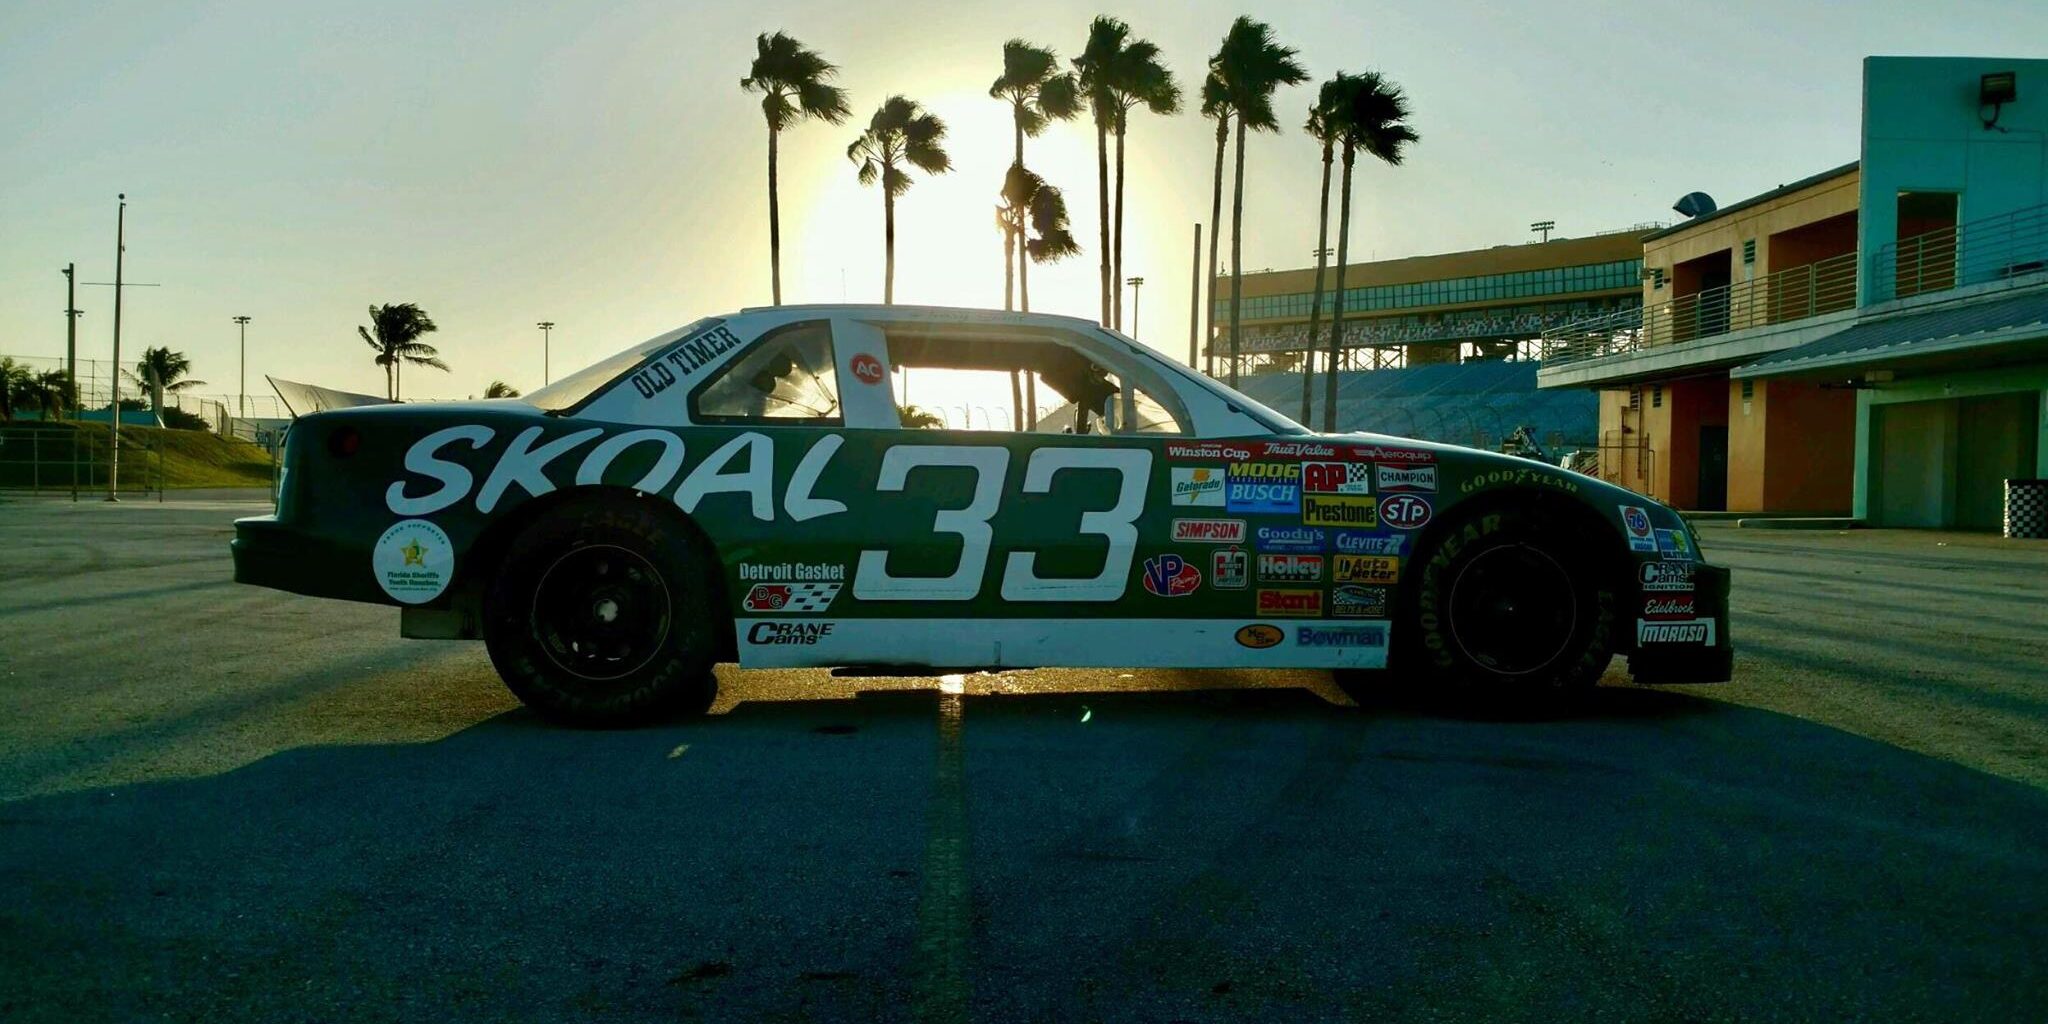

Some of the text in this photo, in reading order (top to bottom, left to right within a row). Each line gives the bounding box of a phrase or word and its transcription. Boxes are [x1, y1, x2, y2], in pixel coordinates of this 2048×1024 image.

[631, 326, 741, 399] OLD TIMER
[856, 360, 881, 378] AC
[1168, 446, 1251, 460] Winston Cup
[1263, 442, 1336, 457] True Value
[1374, 447, 1432, 462] Aeroquip
[386, 424, 848, 521] SKOAL
[1228, 462, 1300, 478] MOOG
[1305, 463, 1346, 491] AP
[1380, 471, 1433, 483] CHAMPION
[1231, 484, 1297, 502] BUSCH
[1305, 498, 1375, 523] Prestone
[1386, 498, 1425, 522] STP
[853, 445, 1153, 601] 33
[1177, 522, 1240, 538] SIMPSON
[1628, 514, 1646, 529] 76
[1257, 527, 1325, 541] Goody's
[740, 563, 845, 580] Detroit Gasket
[1260, 556, 1321, 579] Holley
[1355, 559, 1389, 569] Auto
[1144, 554, 1184, 596] VP
[1352, 569, 1395, 579] Meter
[1644, 599, 1696, 615] Edelbrock
[748, 622, 835, 645] CRANE
[1299, 627, 1384, 646] Bowman
[1642, 625, 1707, 643] MOROSO
